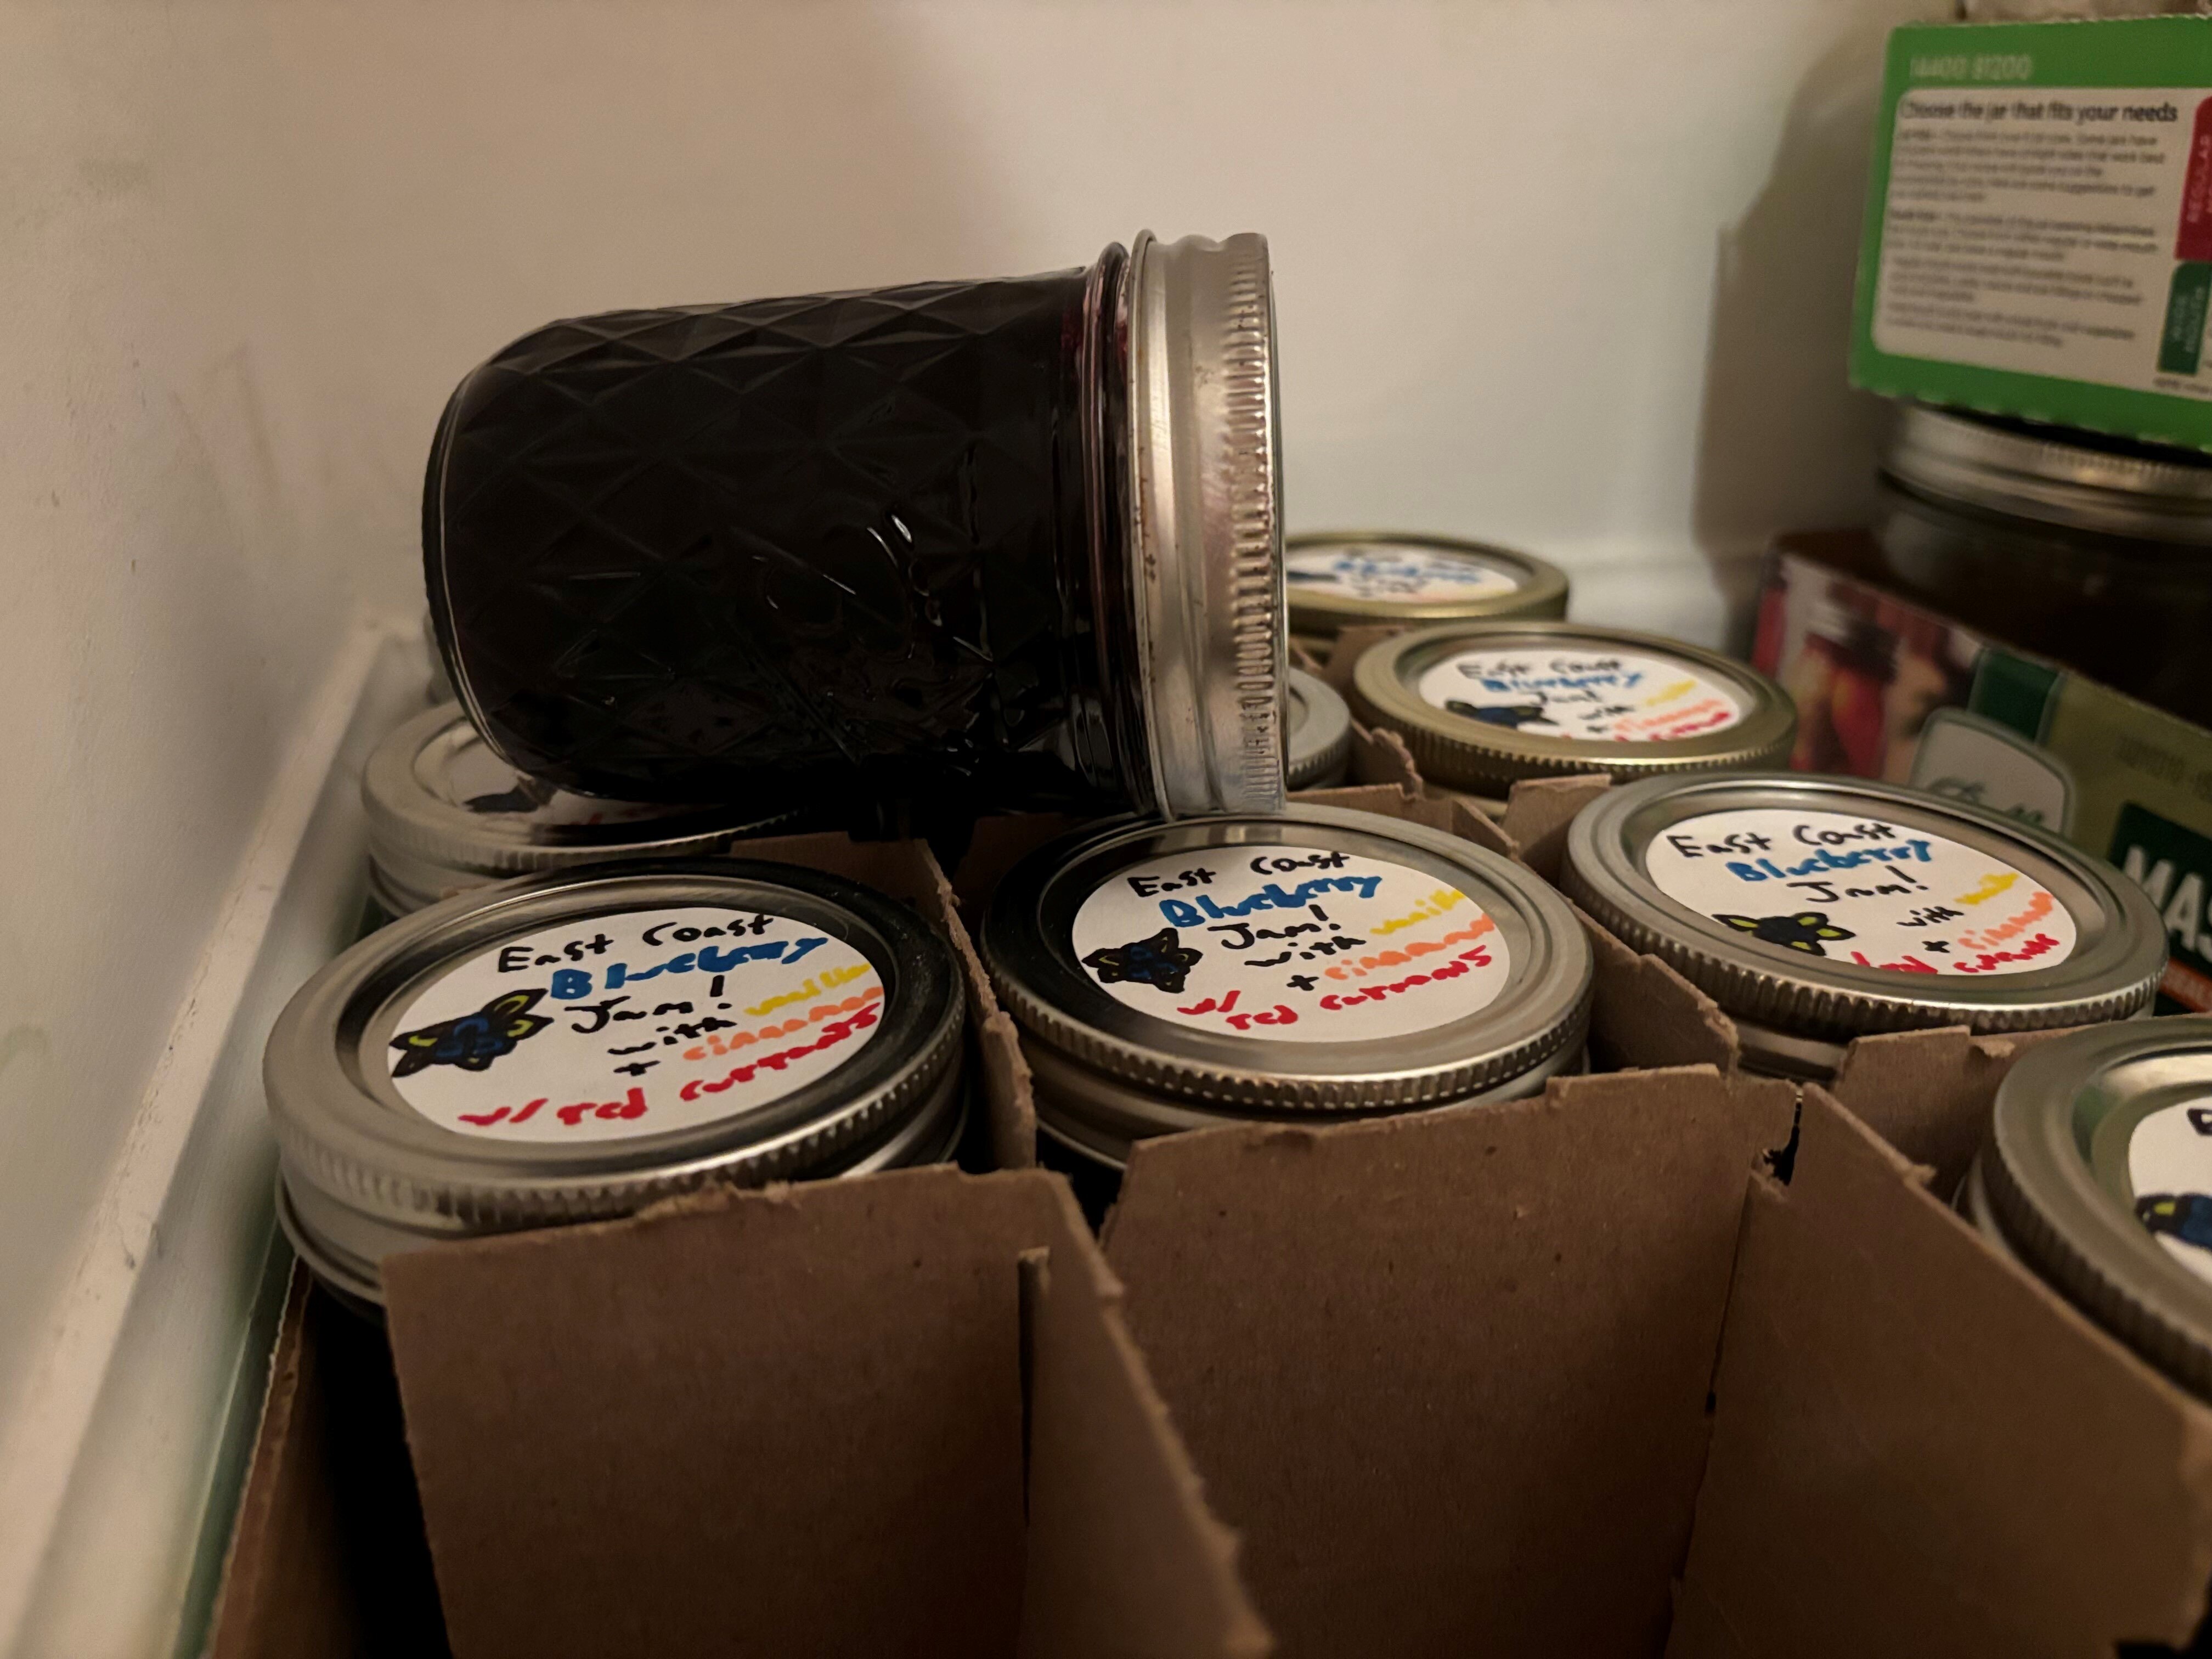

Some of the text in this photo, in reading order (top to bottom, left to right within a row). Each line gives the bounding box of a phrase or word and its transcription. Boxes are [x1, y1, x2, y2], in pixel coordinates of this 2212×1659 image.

[1899, 101, 2179, 126] Choose the jar that fits your needs
[1666, 822, 1898, 859] East Coast
[1127, 851, 1351, 898] East Coast
[1725, 840, 1934, 882] Blueberry
[1158, 876, 1383, 927] Blueberry
[1786, 865, 1931, 903] Jam!
[1207, 905, 1342, 950] Jam!
[1896, 906, 1965, 927] with
[497, 913, 774, 972] East Coast
[1244, 936, 1366, 967] with
[550, 936, 829, 1000] Blueberry
[1286, 974, 1319, 991] +
[564, 974, 733, 1034] Jam!
[1225, 1005, 1299, 1030] red
[607, 1014, 737, 1055] with
[614, 1059, 662, 1075] +
[457, 1098, 548, 1126] w/
[556, 1087, 648, 1125] red
